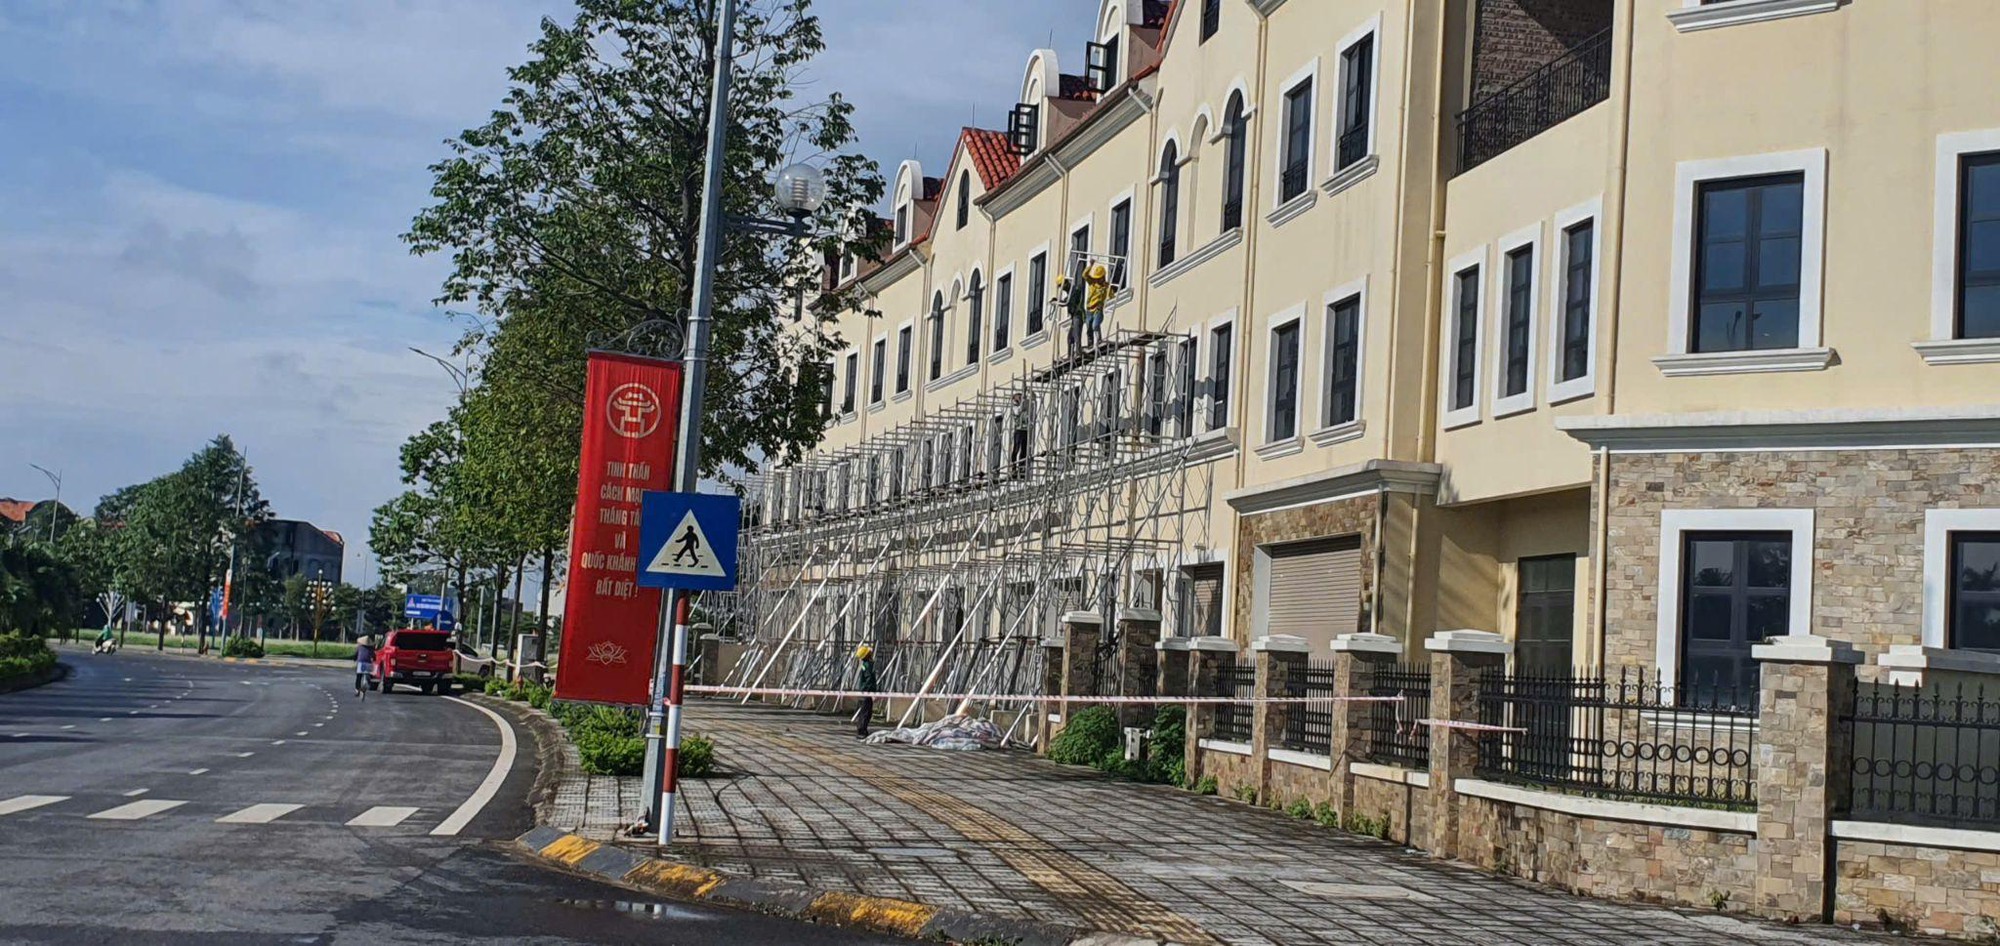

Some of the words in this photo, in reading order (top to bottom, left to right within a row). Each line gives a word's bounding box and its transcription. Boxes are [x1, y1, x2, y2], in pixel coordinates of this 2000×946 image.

[607, 461, 626, 478] TINH
[600, 482, 624, 502] CÁCH
[625, 487, 645, 506] MẠ
[600, 506, 627, 526] THÁNG
[630, 508, 642, 527] TÁ
[615, 531, 626, 550] VÀ
[581, 551, 605, 570] QUỐC
[606, 552, 636, 572] KHÁNH
[596, 577, 614, 595] BẤT
[614, 579, 634, 600] DIỆT
